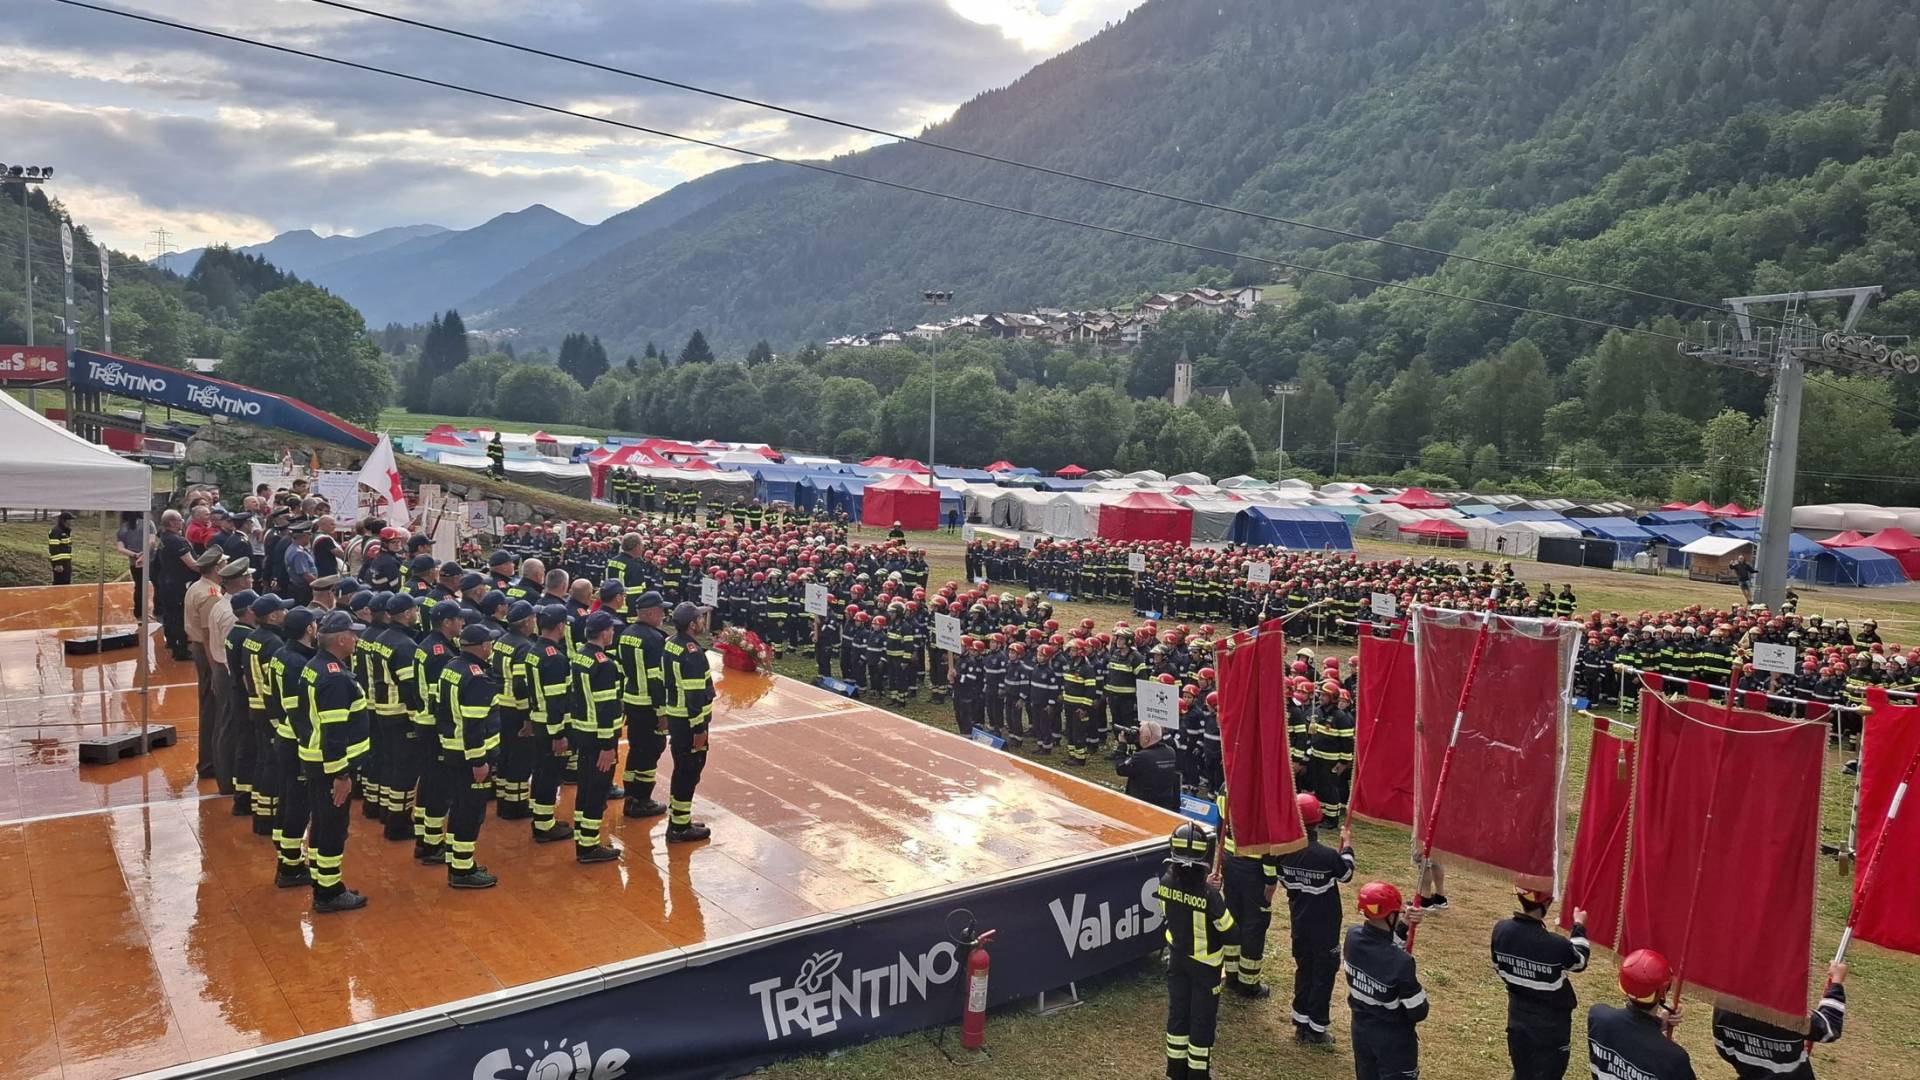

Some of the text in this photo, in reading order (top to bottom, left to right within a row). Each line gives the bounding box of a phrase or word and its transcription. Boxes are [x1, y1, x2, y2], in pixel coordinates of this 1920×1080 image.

[12, 352, 58, 371] Sole
[88, 361, 166, 392] TRENTINO
[187, 384, 260, 416] TRENTINO
[1172, 889, 1183, 903] DEL
[1183, 892, 1207, 910] FUOCO
[1048, 893, 1111, 959] Val
[1115, 903, 1139, 940] di
[1515, 959, 1527, 969] DEL
[1528, 962, 1552, 975] FUOCO
[749, 941, 959, 1041] TRENTINO
[1744, 1044, 1773, 1059] ALLIEVI
[1747, 1036, 1761, 1047] DEL
[1762, 1040, 1792, 1052] FUOCO
[1613, 1055, 1626, 1071] DEL
